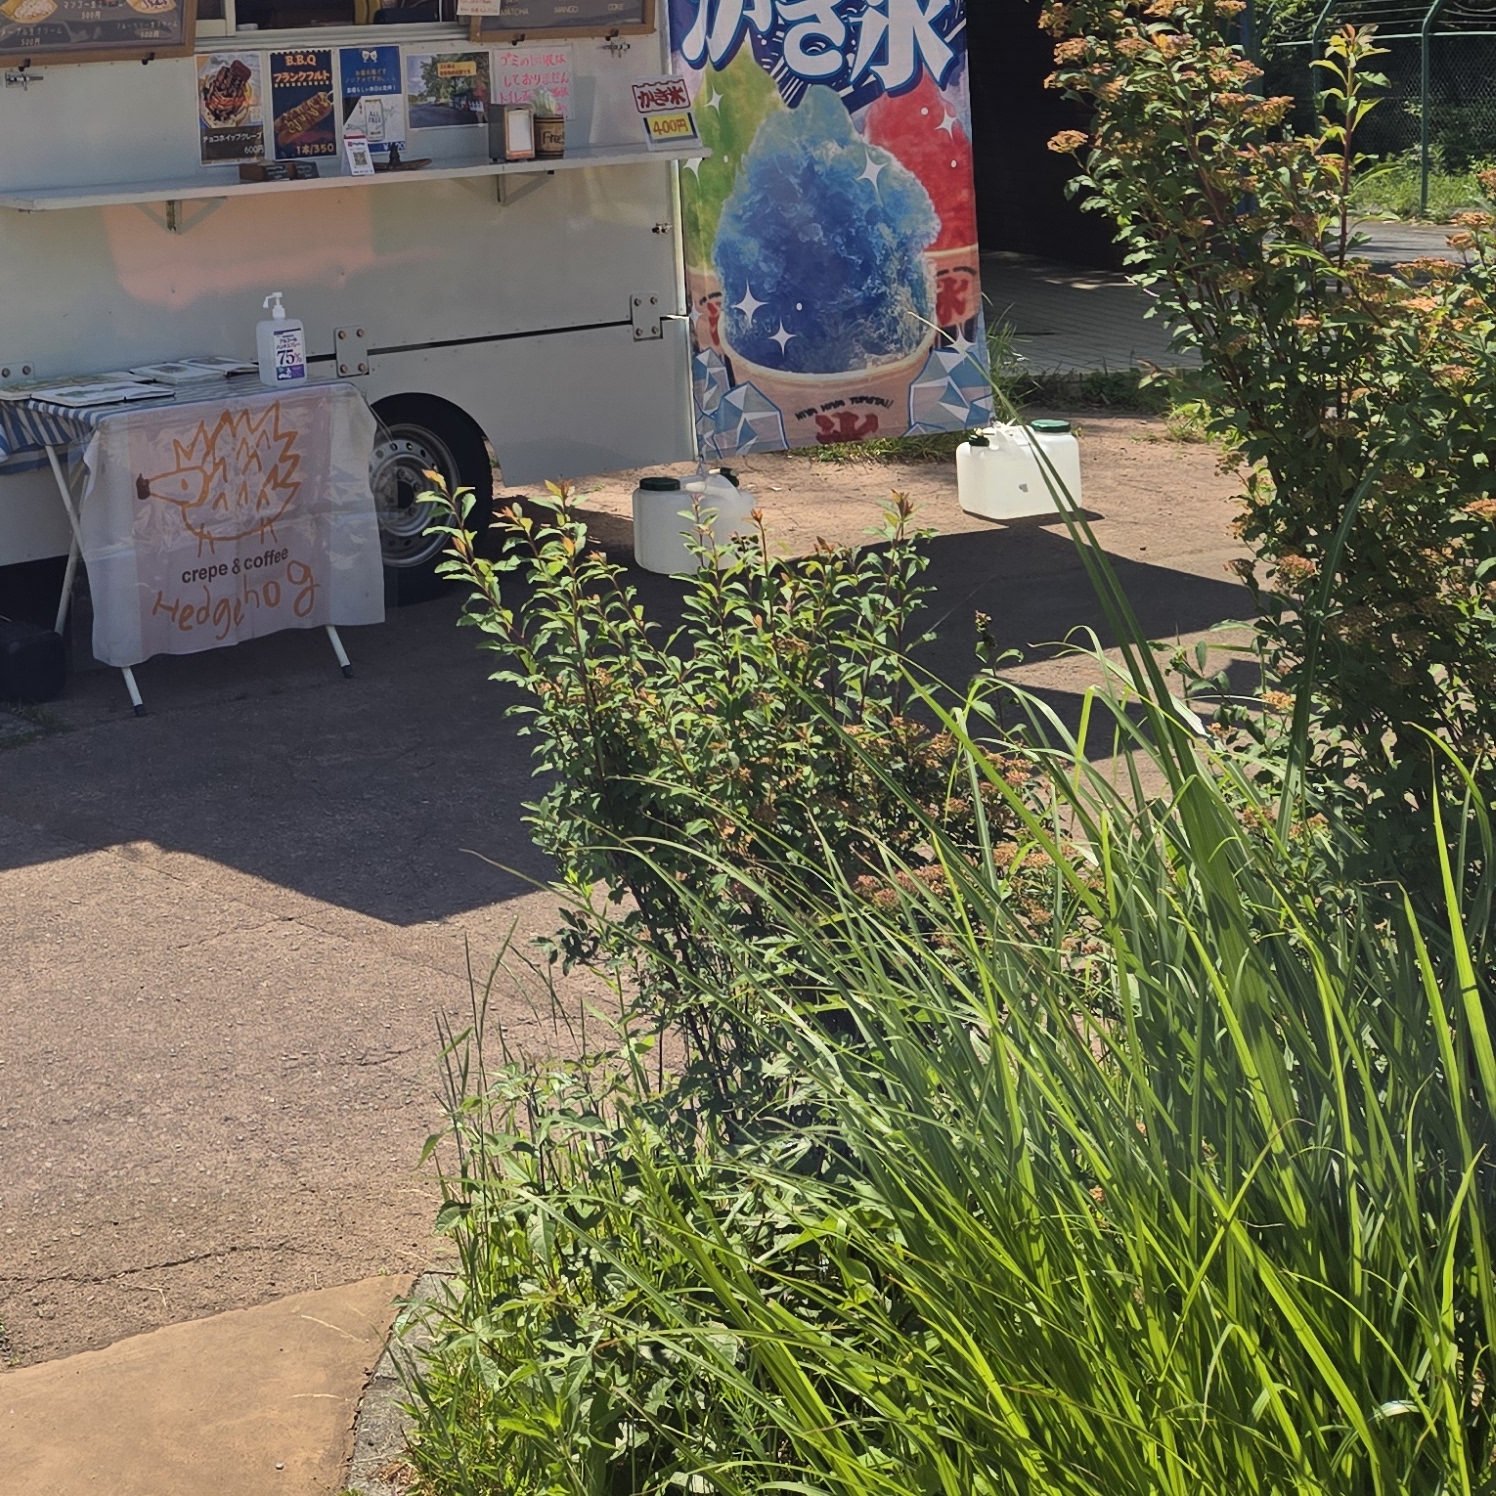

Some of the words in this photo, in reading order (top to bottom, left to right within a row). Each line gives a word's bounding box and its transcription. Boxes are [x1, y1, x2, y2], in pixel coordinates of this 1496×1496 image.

[284, 54, 317, 66] B.B.Q
[272, 69, 331, 83] フランクフルト
[637, 85, 686, 109] かき氷
[653, 118, 690, 135] 400円
[202, 131, 263, 144] チョコホイップクレープ
[296, 142, 335, 156] 1本/350
[277, 348, 303, 366] 75%
[181, 560, 229, 585] crepe
[232, 557, 242, 575] &
[243, 546, 289, 570] coffee
[152, 561, 320, 641] Hedgehog
